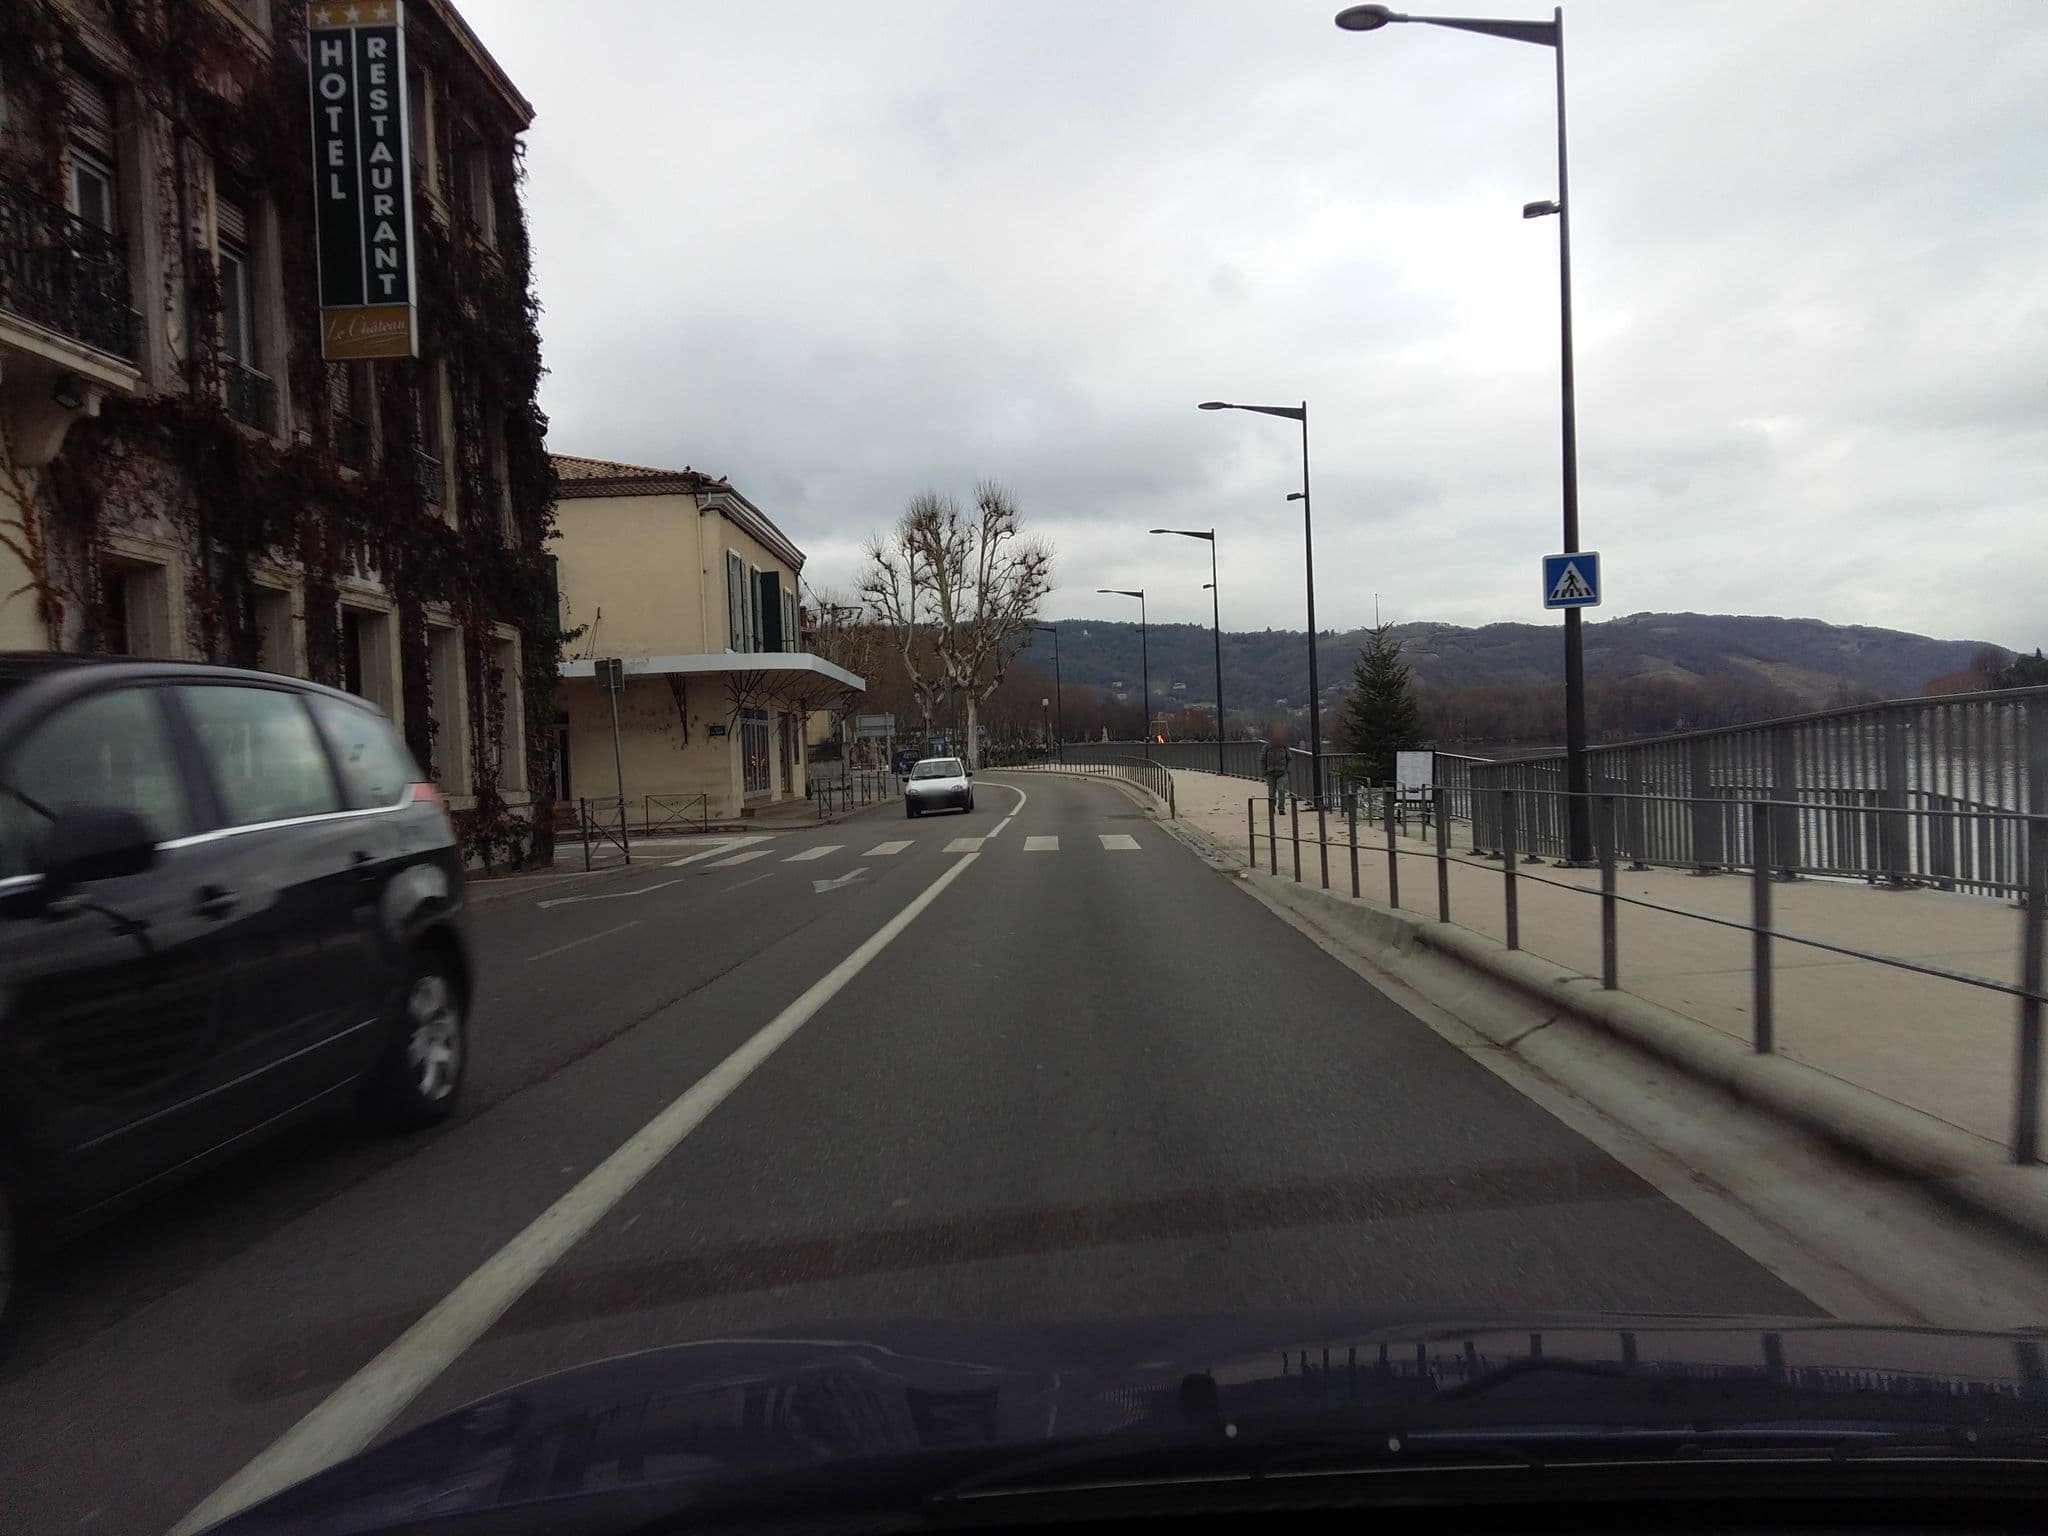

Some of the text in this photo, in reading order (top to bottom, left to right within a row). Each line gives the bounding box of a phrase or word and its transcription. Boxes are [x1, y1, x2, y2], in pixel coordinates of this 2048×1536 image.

[319, 39, 347, 200] HOTEL
[366, 37, 399, 295] RESTAURANT
[327, 319, 345, 340] Le
